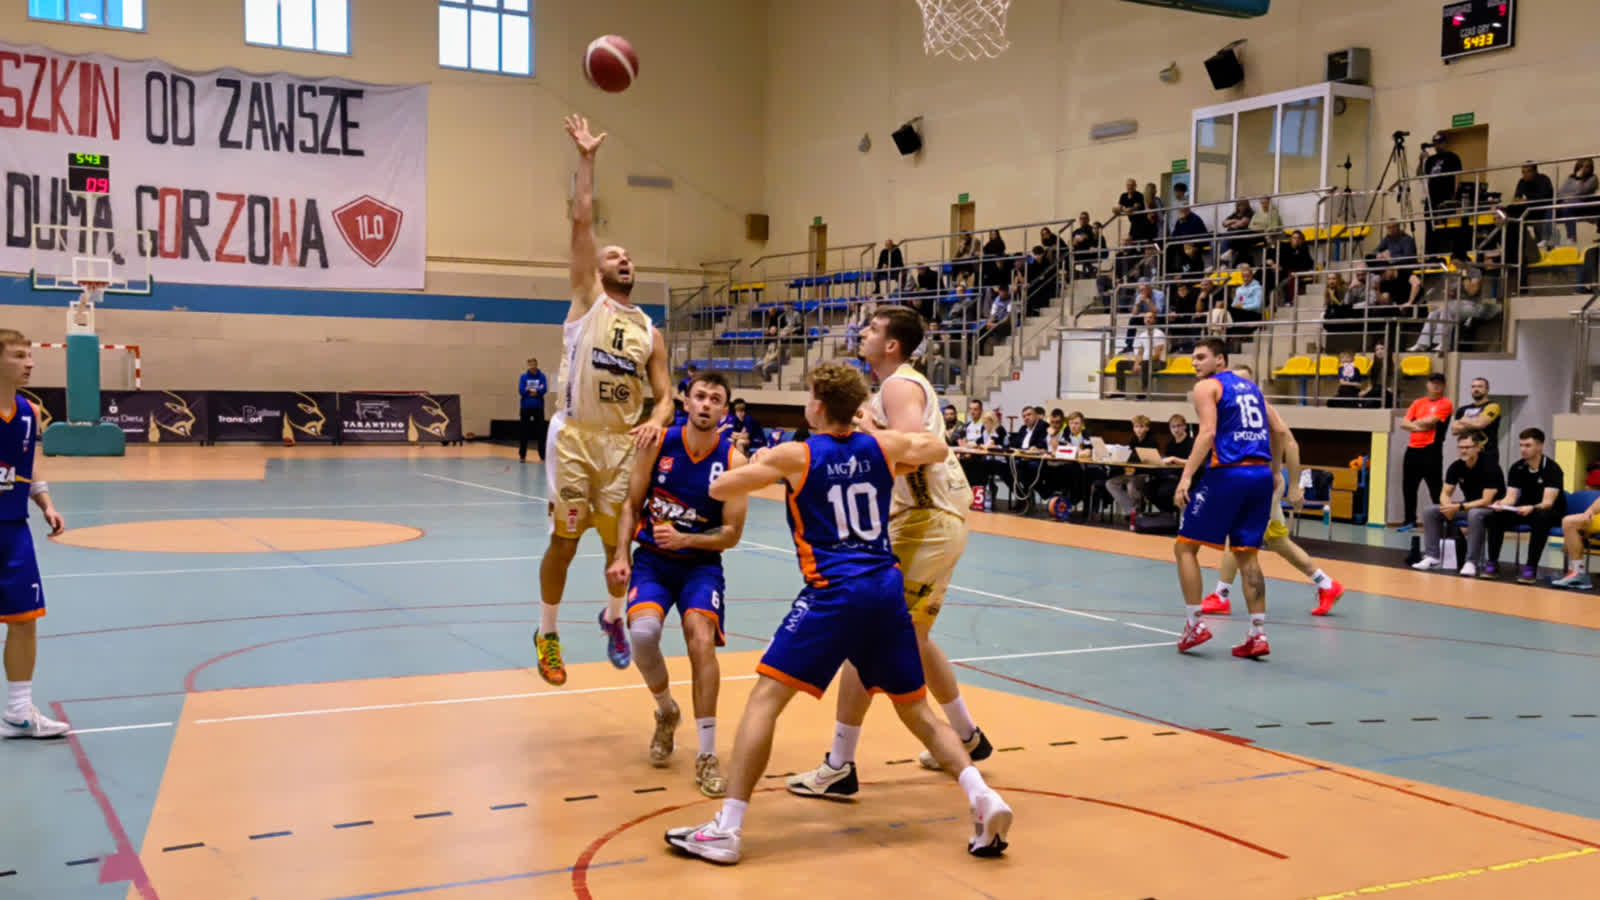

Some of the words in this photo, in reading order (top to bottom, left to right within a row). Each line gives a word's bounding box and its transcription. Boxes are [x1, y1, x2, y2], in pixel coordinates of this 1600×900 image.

[146, 71, 195, 146] OD
[216, 78, 365, 156] ZAWSZE
[136, 185, 329, 269] GORZOWA
[1236, 393, 1263, 428] 16
[21, 416, 31, 439] 7
[343, 421, 405, 429] TARANTINO
[974, 488, 984, 504] 5
[827, 482, 882, 541] 10
[32, 583, 40, 603] 7
[712, 590, 720, 609] 6
